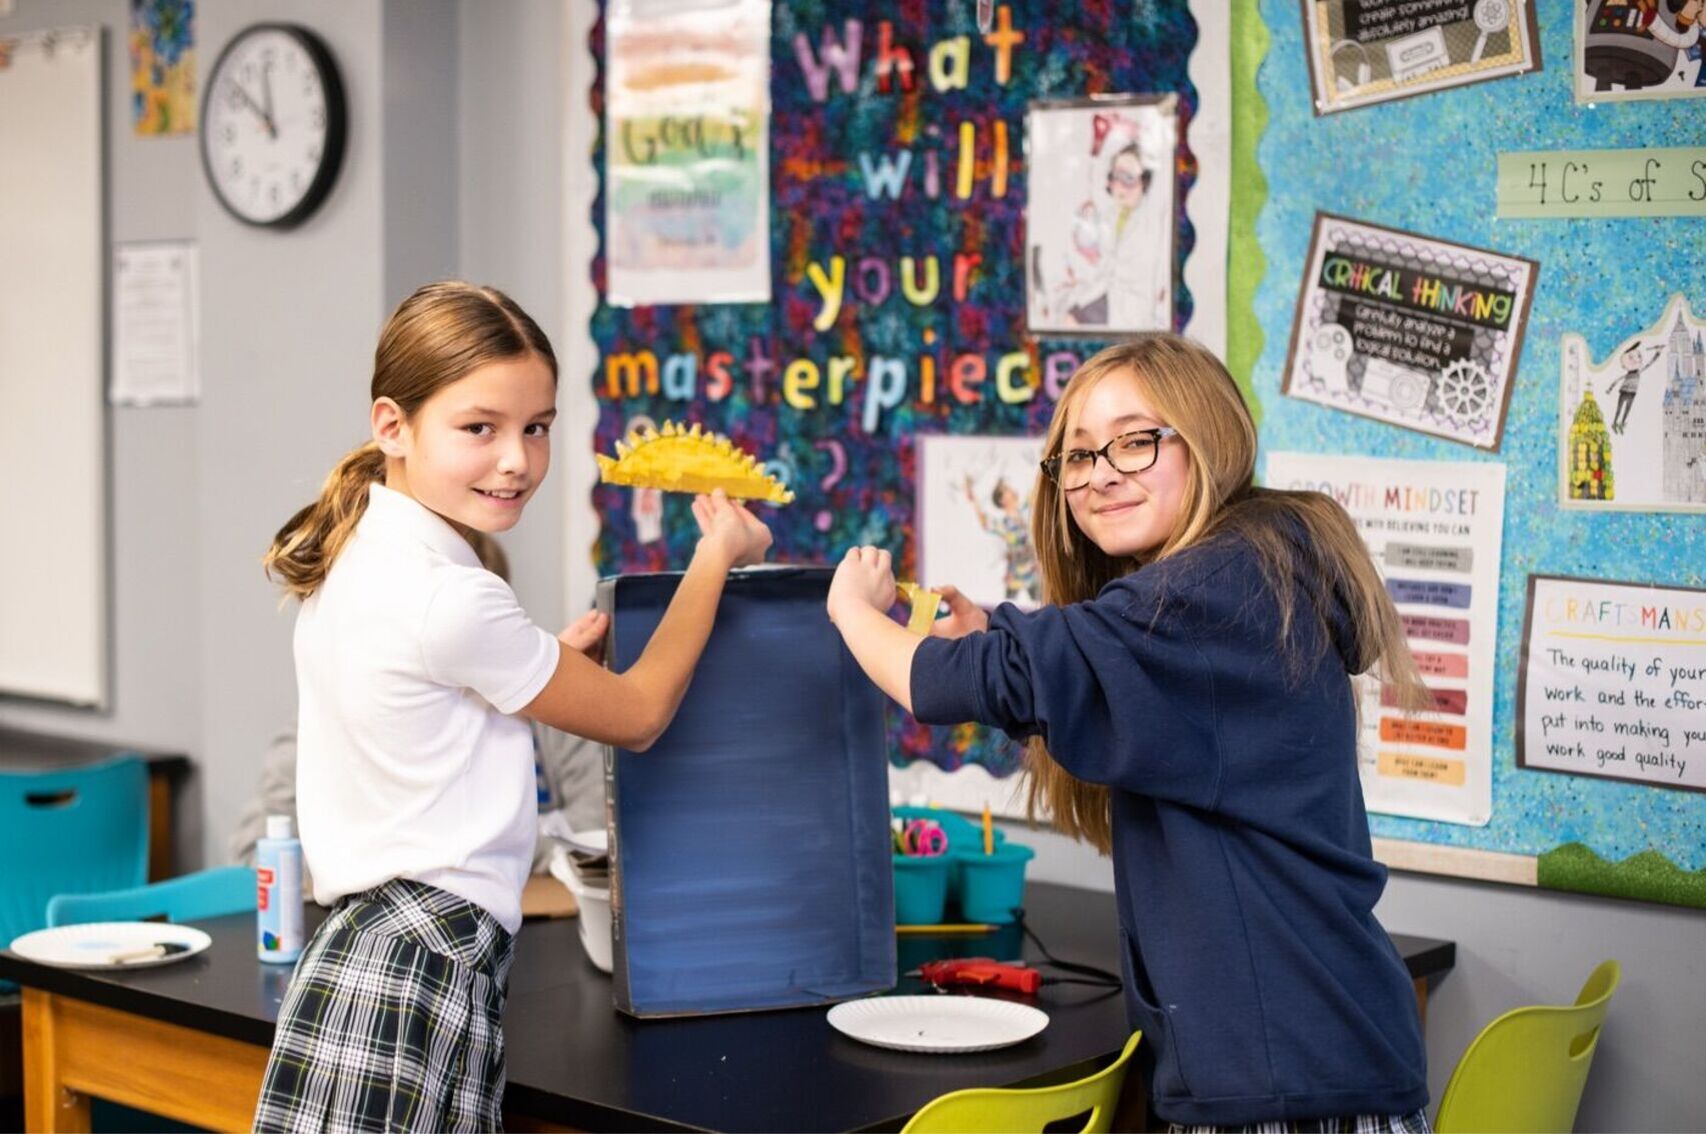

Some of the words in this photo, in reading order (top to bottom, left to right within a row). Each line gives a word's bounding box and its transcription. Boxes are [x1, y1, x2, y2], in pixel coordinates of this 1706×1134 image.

[792, 4, 1025, 102] What
[858, 119, 1009, 200] will
[1529, 162, 1547, 205] 4
[1562, 161, 1603, 204] C's
[1629, 158, 1661, 202] of
[807, 255, 982, 332] your
[605, 328, 1080, 432] masterpiece
[1384, 485, 1479, 516] MINDSET
[1452, 523, 1471, 535] CAN
[1546, 648, 1575, 667] The
[1582, 653, 1636, 682] quality
[1645, 657, 1663, 677] of
[1545, 684, 1584, 702] work
[1598, 690, 1625, 706] and
[1634, 690, 1656, 707] the
[1665, 690, 1706, 710] effor
[1541, 712, 1567, 737] put
[1574, 715, 1605, 733] into
[1613, 719, 1670, 748] making
[1546, 742, 1585, 758] work
[1596, 746, 1626, 768] good
[1635, 752, 1686, 778] quality
